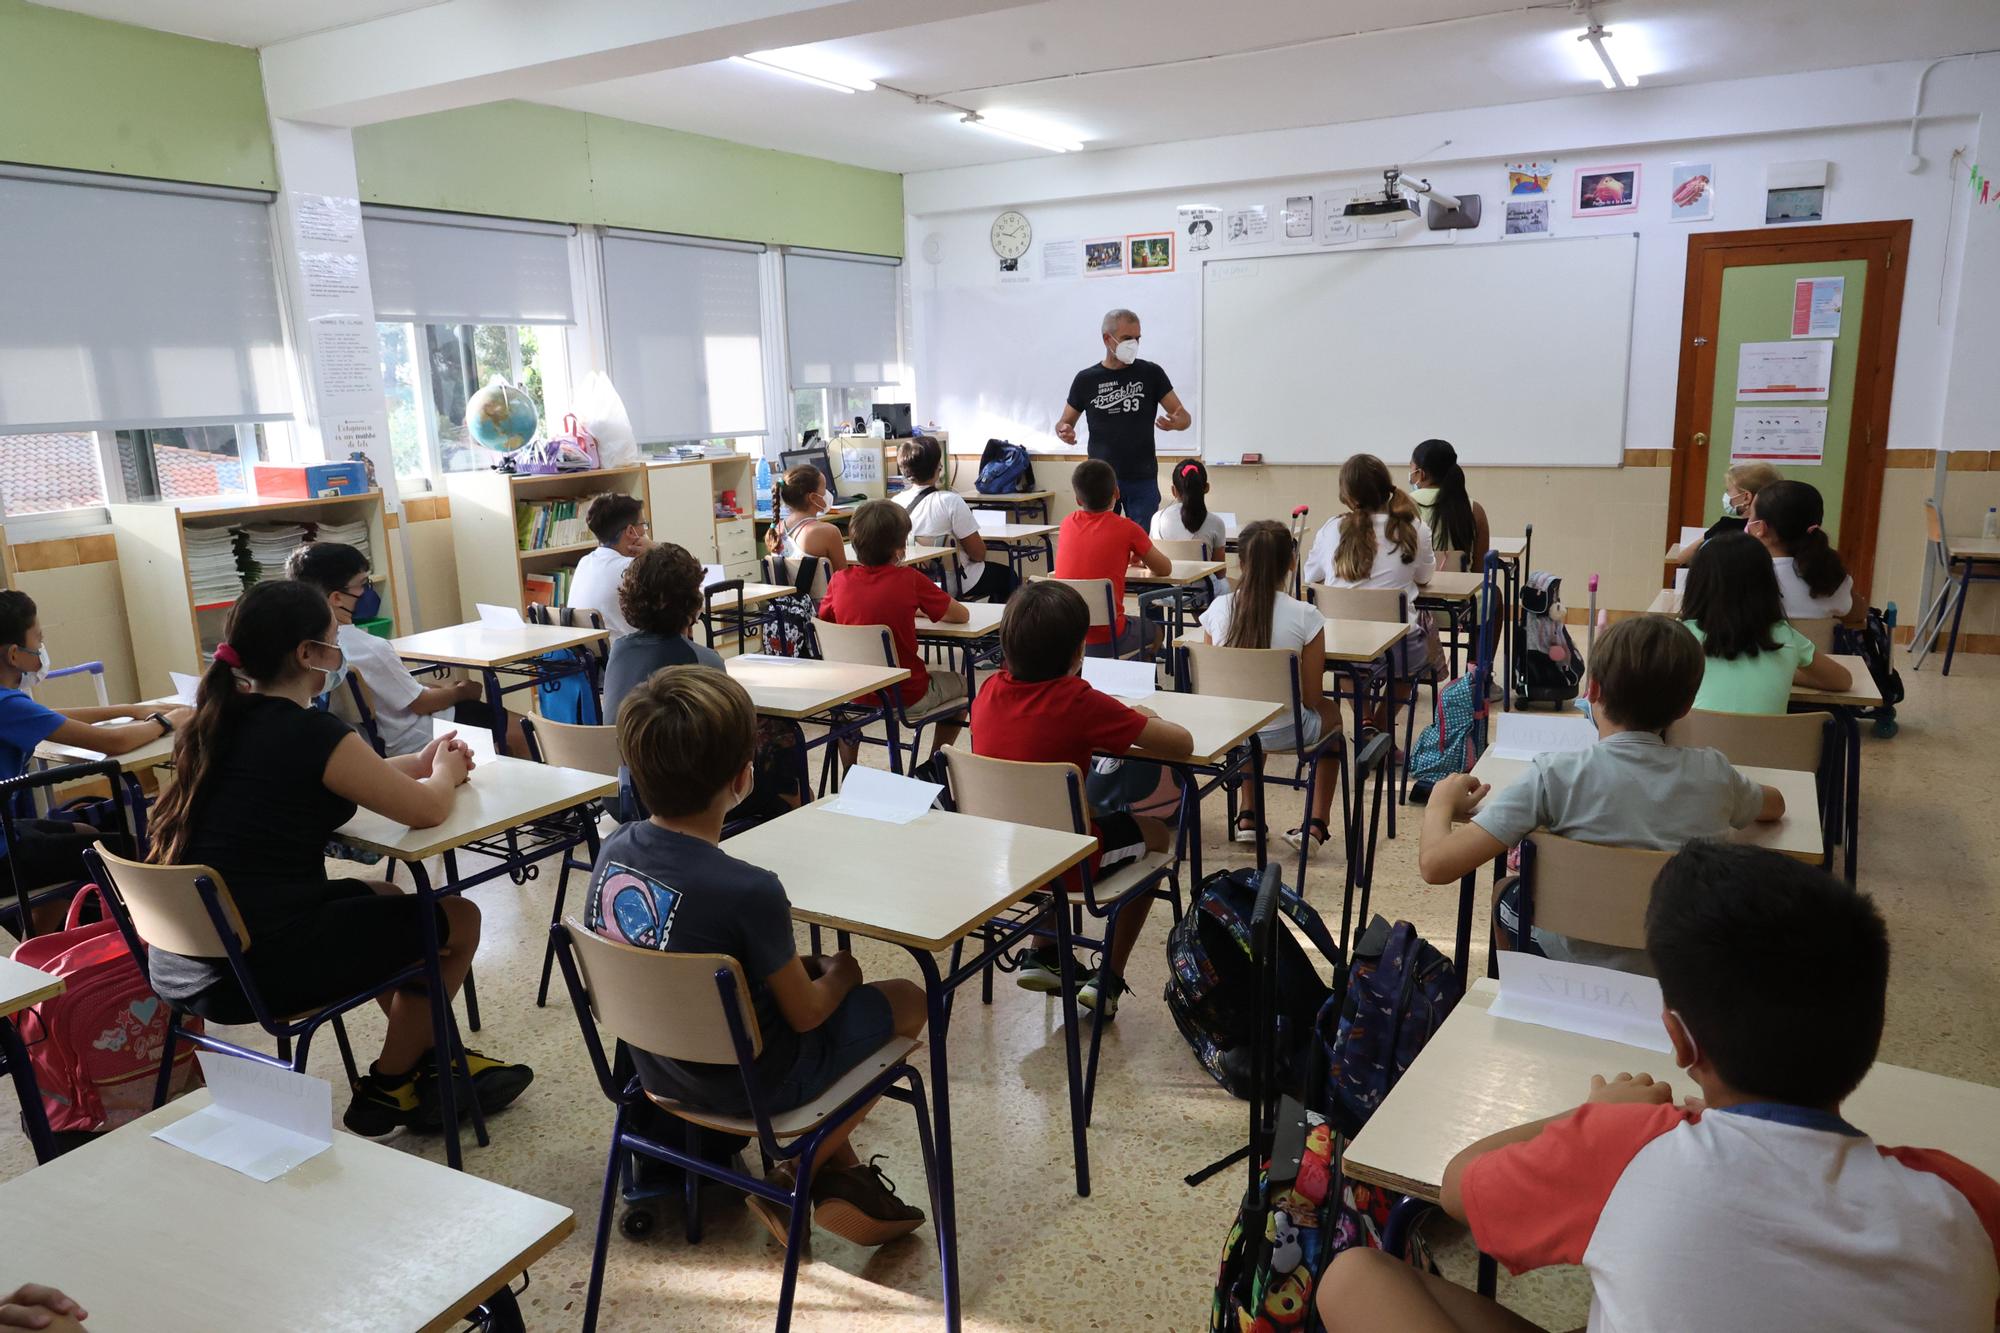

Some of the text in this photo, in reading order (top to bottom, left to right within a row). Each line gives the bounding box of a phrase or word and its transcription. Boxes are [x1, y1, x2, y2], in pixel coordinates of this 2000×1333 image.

[1098, 380, 1119, 388] ORIGINAL
[1090, 381, 1145, 409] Brooklyn
[1123, 398, 1140, 413] 93
